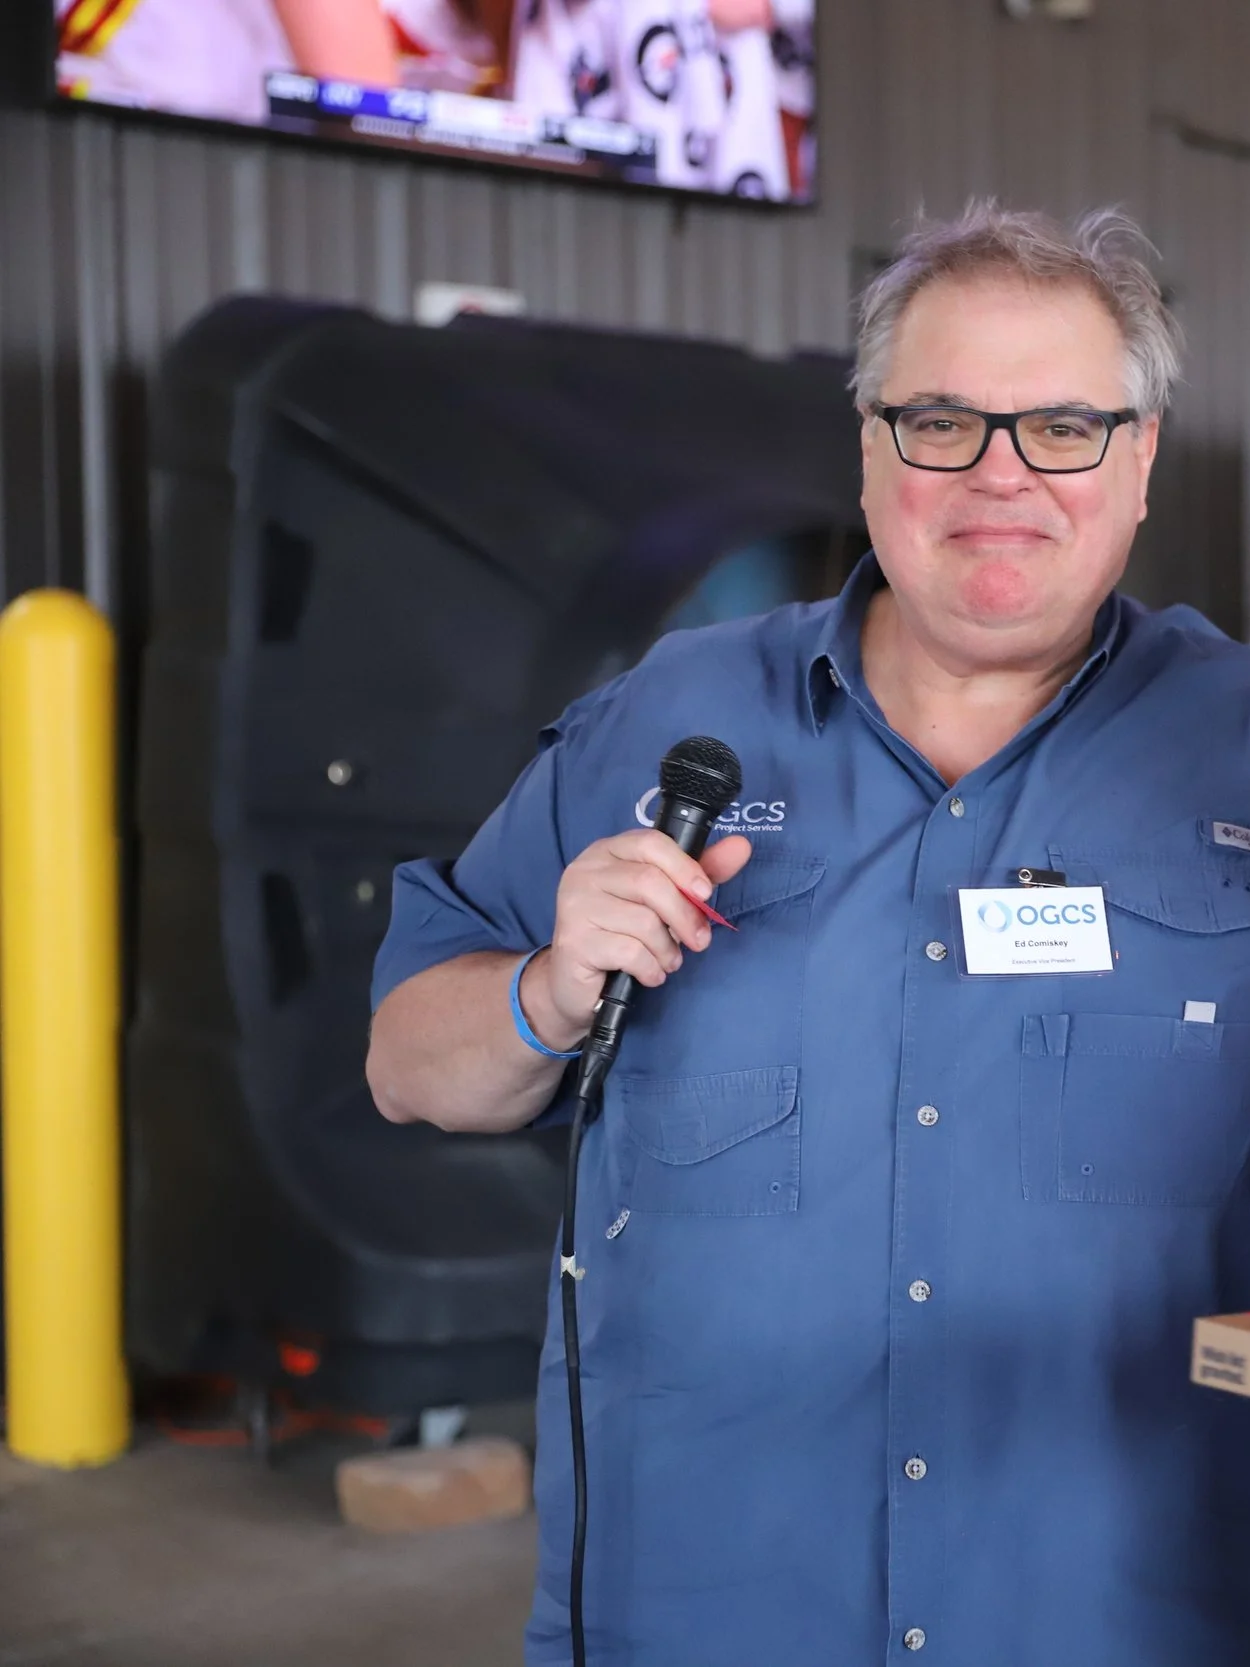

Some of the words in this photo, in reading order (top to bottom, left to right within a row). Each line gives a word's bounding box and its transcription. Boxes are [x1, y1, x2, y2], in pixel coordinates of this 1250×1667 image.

[717, 801, 786, 823] GCS
[714, 823, 747, 833] Project
[747, 824, 784, 832] Services
[1016, 904, 1097, 926] OGCS
[1014, 940, 1026, 948] Ed
[1028, 939, 1069, 948] Comiskey
